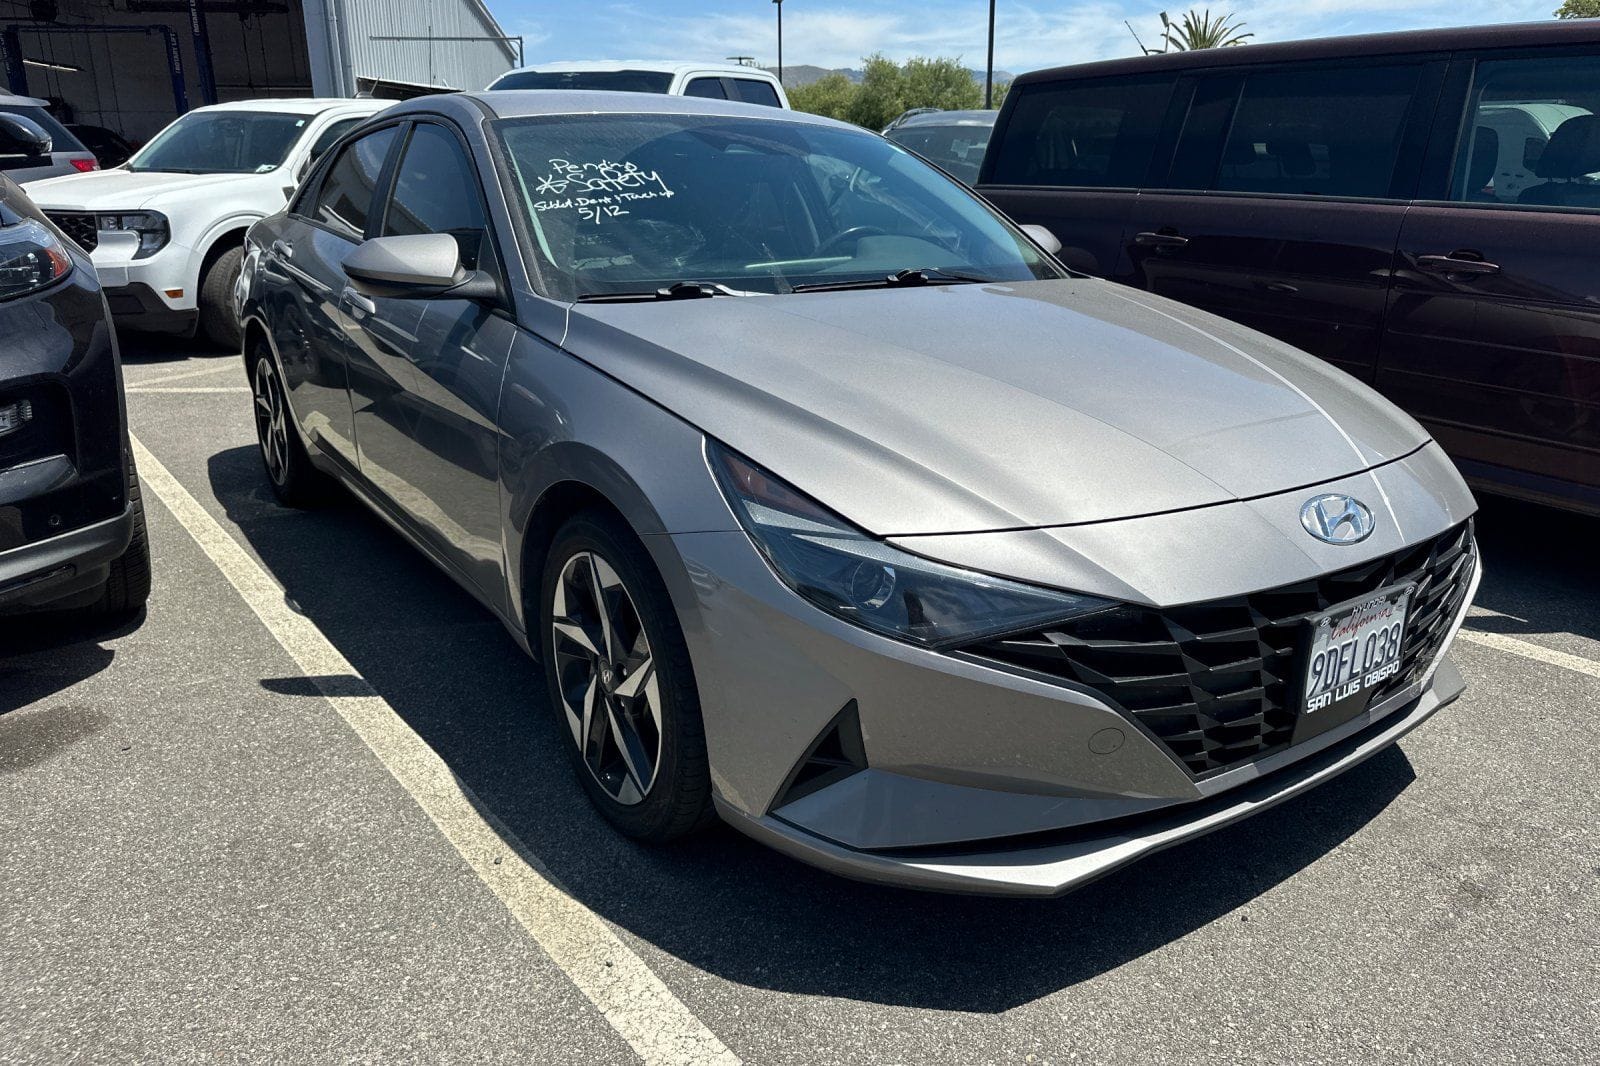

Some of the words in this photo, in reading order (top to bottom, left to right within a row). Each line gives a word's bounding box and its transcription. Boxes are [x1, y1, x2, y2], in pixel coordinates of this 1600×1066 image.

[173, 47, 181, 71] ROTARY
[549, 159, 637, 173] Pending
[578, 205, 630, 225] 5/12
[1331, 608, 1392, 640] California
[1308, 622, 1401, 698] 9DFL038
[1306, 692, 1332, 714] SAN
[1335, 679, 1361, 702] LUIS
[1364, 661, 1400, 688] OBISPO
